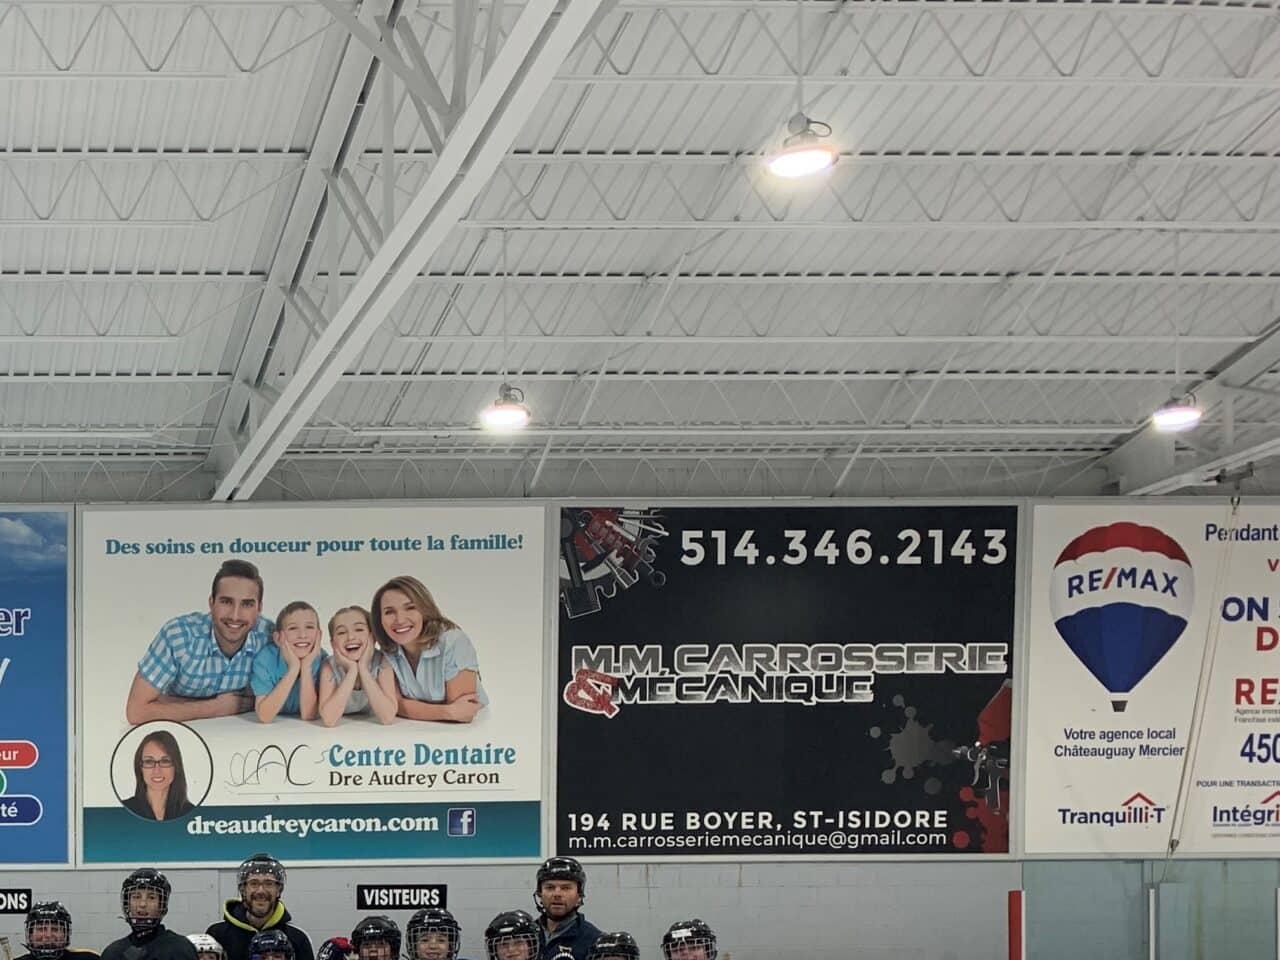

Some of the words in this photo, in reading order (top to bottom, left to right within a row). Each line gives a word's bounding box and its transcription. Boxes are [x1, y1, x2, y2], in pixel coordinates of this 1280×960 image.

[1205, 523, 1279, 541] Pendant
[105, 539, 141, 555] Des
[145, 538, 195, 555] soins
[200, 541, 224, 554] en
[229, 538, 311, 554] douceur
[316, 539, 364, 557] pour
[369, 537, 422, 552] toute
[427, 536, 445, 551] la
[449, 534, 524, 551] famille!
[680, 529, 1008, 565] 514.346.2143
[1067, 566, 1179, 598] RE/MAX
[1221, 596, 1269, 622] ON
[674, 643, 1009, 674] CARROSSERIE
[1064, 728, 1097, 740] Votre
[1099, 730, 1144, 744] agence
[1147, 728, 1176, 741] local
[328, 744, 406, 768] Centre
[414, 743, 517, 766] Dentaire
[1054, 744, 1136, 760] Châteauguay
[1138, 744, 1185, 758] Mercier
[329, 771, 363, 787] Dre
[368, 770, 437, 790] Audrey
[443, 769, 500, 786] Caron
[187, 814, 439, 838] dreaudreycaron.com
[568, 813, 611, 831] 194
[622, 813, 674, 831] RUE
[686, 812, 782, 833] BOYER,
[793, 810, 948, 829] ST-ISIDORE
[569, 831, 948, 850] m.m.carrosseriemecanique@gmail.com
[364, 889, 440, 906] VISITEURS
